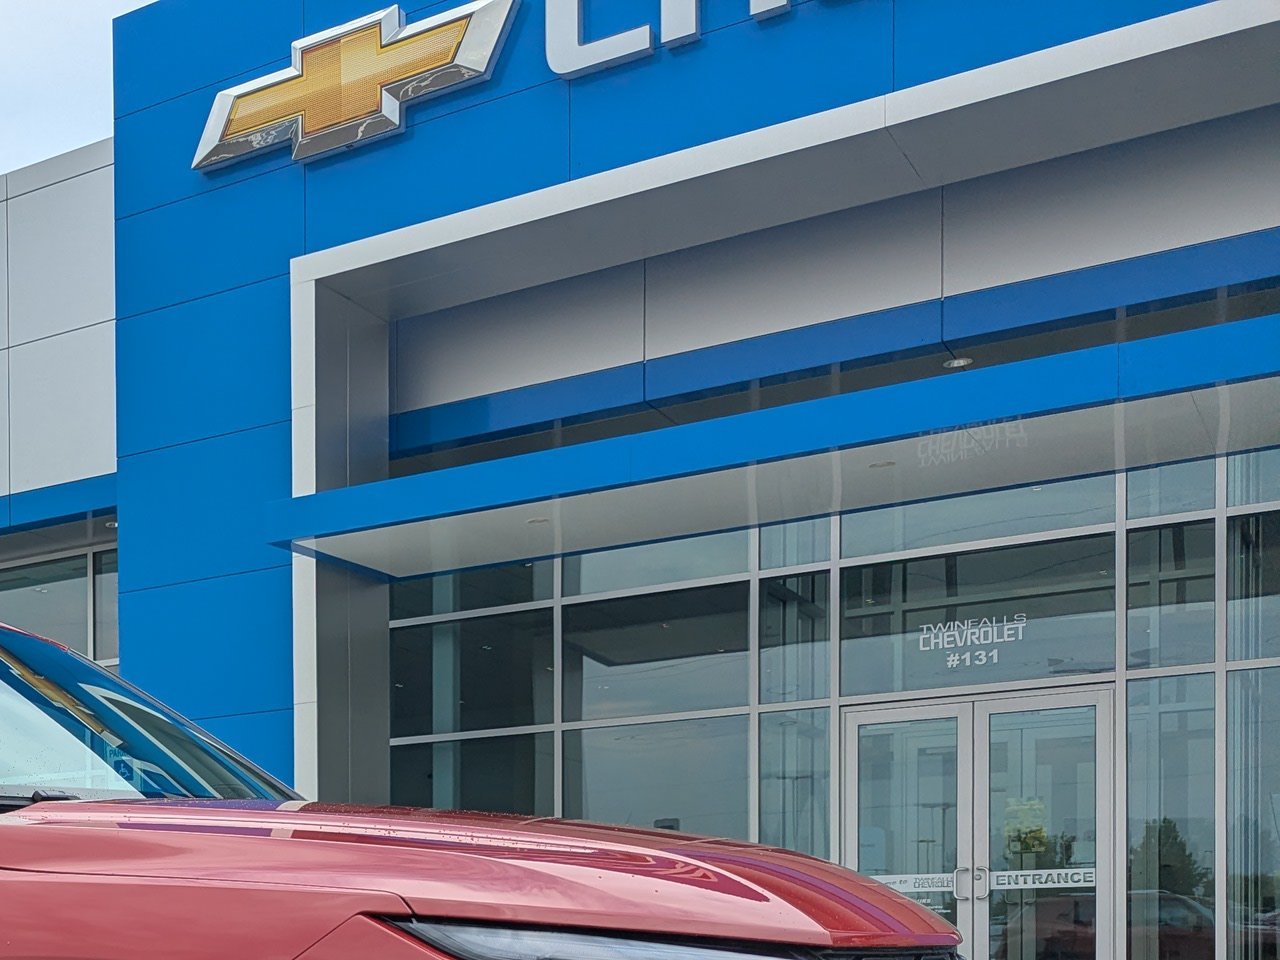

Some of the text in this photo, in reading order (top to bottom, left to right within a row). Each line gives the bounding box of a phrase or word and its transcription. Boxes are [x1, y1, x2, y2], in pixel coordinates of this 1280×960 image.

[919, 623, 1026, 650] CHEVROLET
[947, 648, 999, 668] #131
[995, 871, 1094, 887] ENTRANCE
